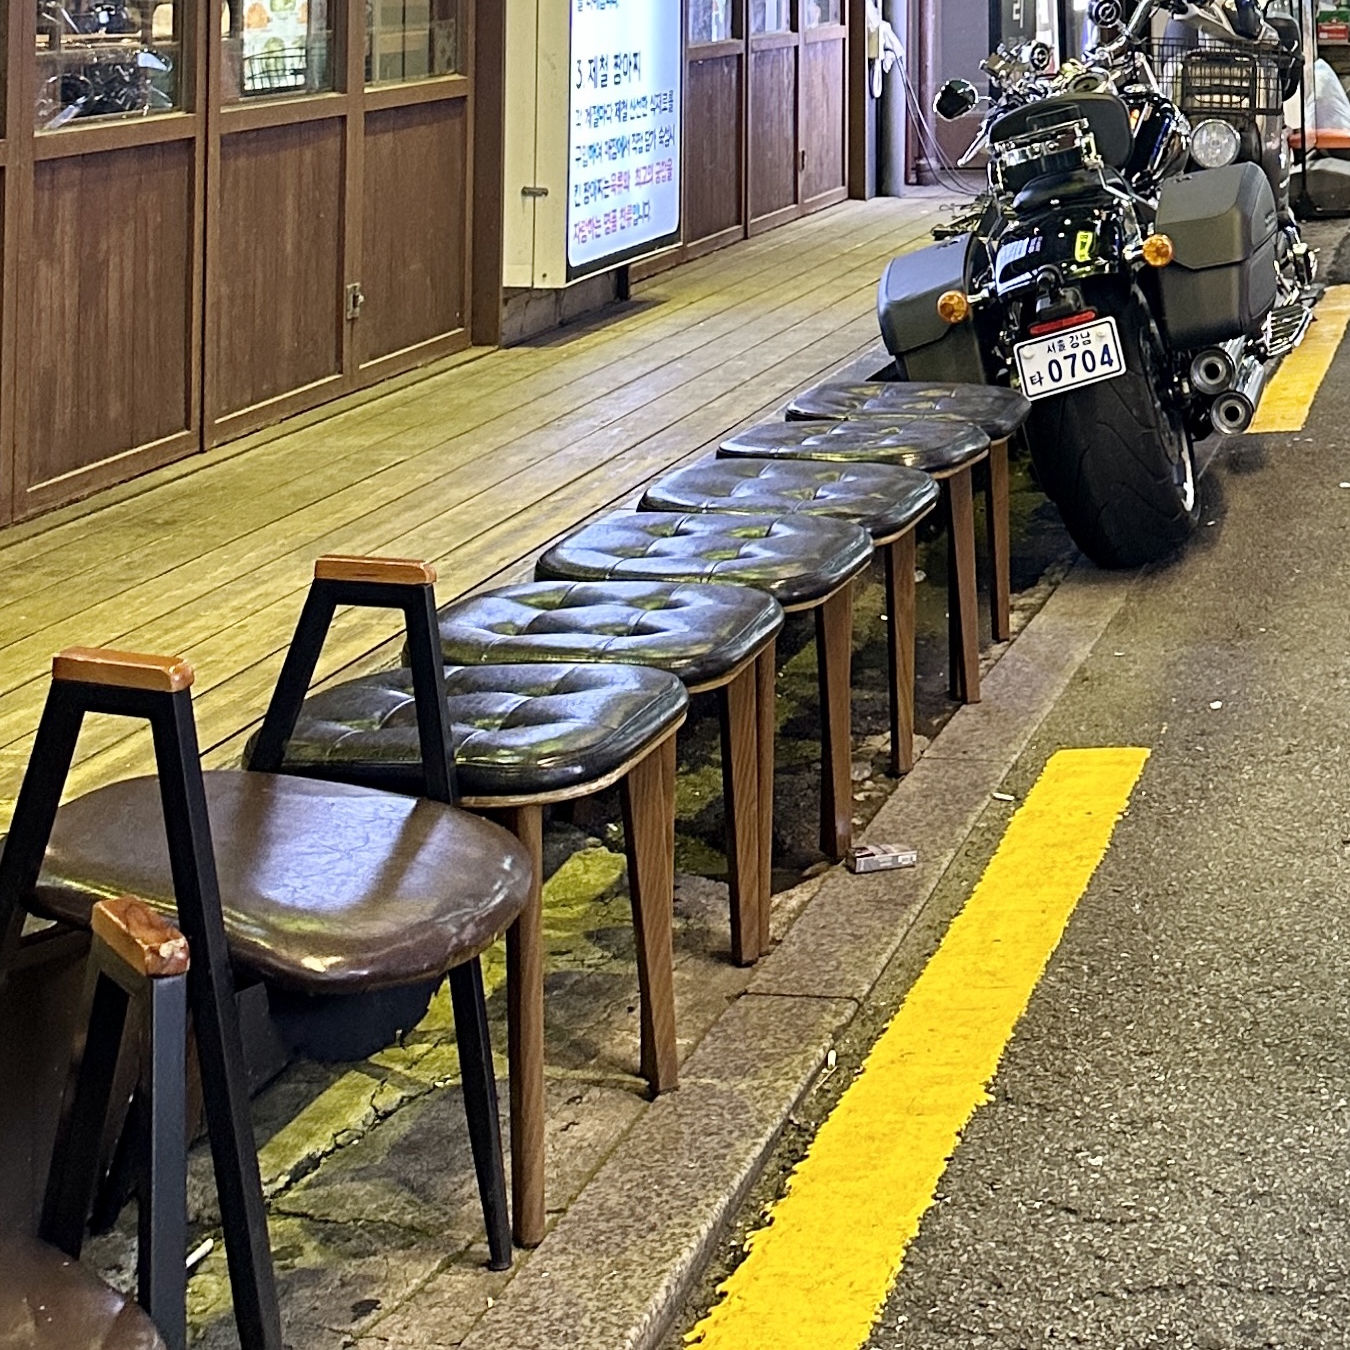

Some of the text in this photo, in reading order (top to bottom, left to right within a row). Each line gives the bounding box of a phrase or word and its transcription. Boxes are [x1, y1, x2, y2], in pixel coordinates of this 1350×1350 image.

[1047, 331, 1091, 354] 서울 강남
[1029, 343, 1114, 386] 타 0704
